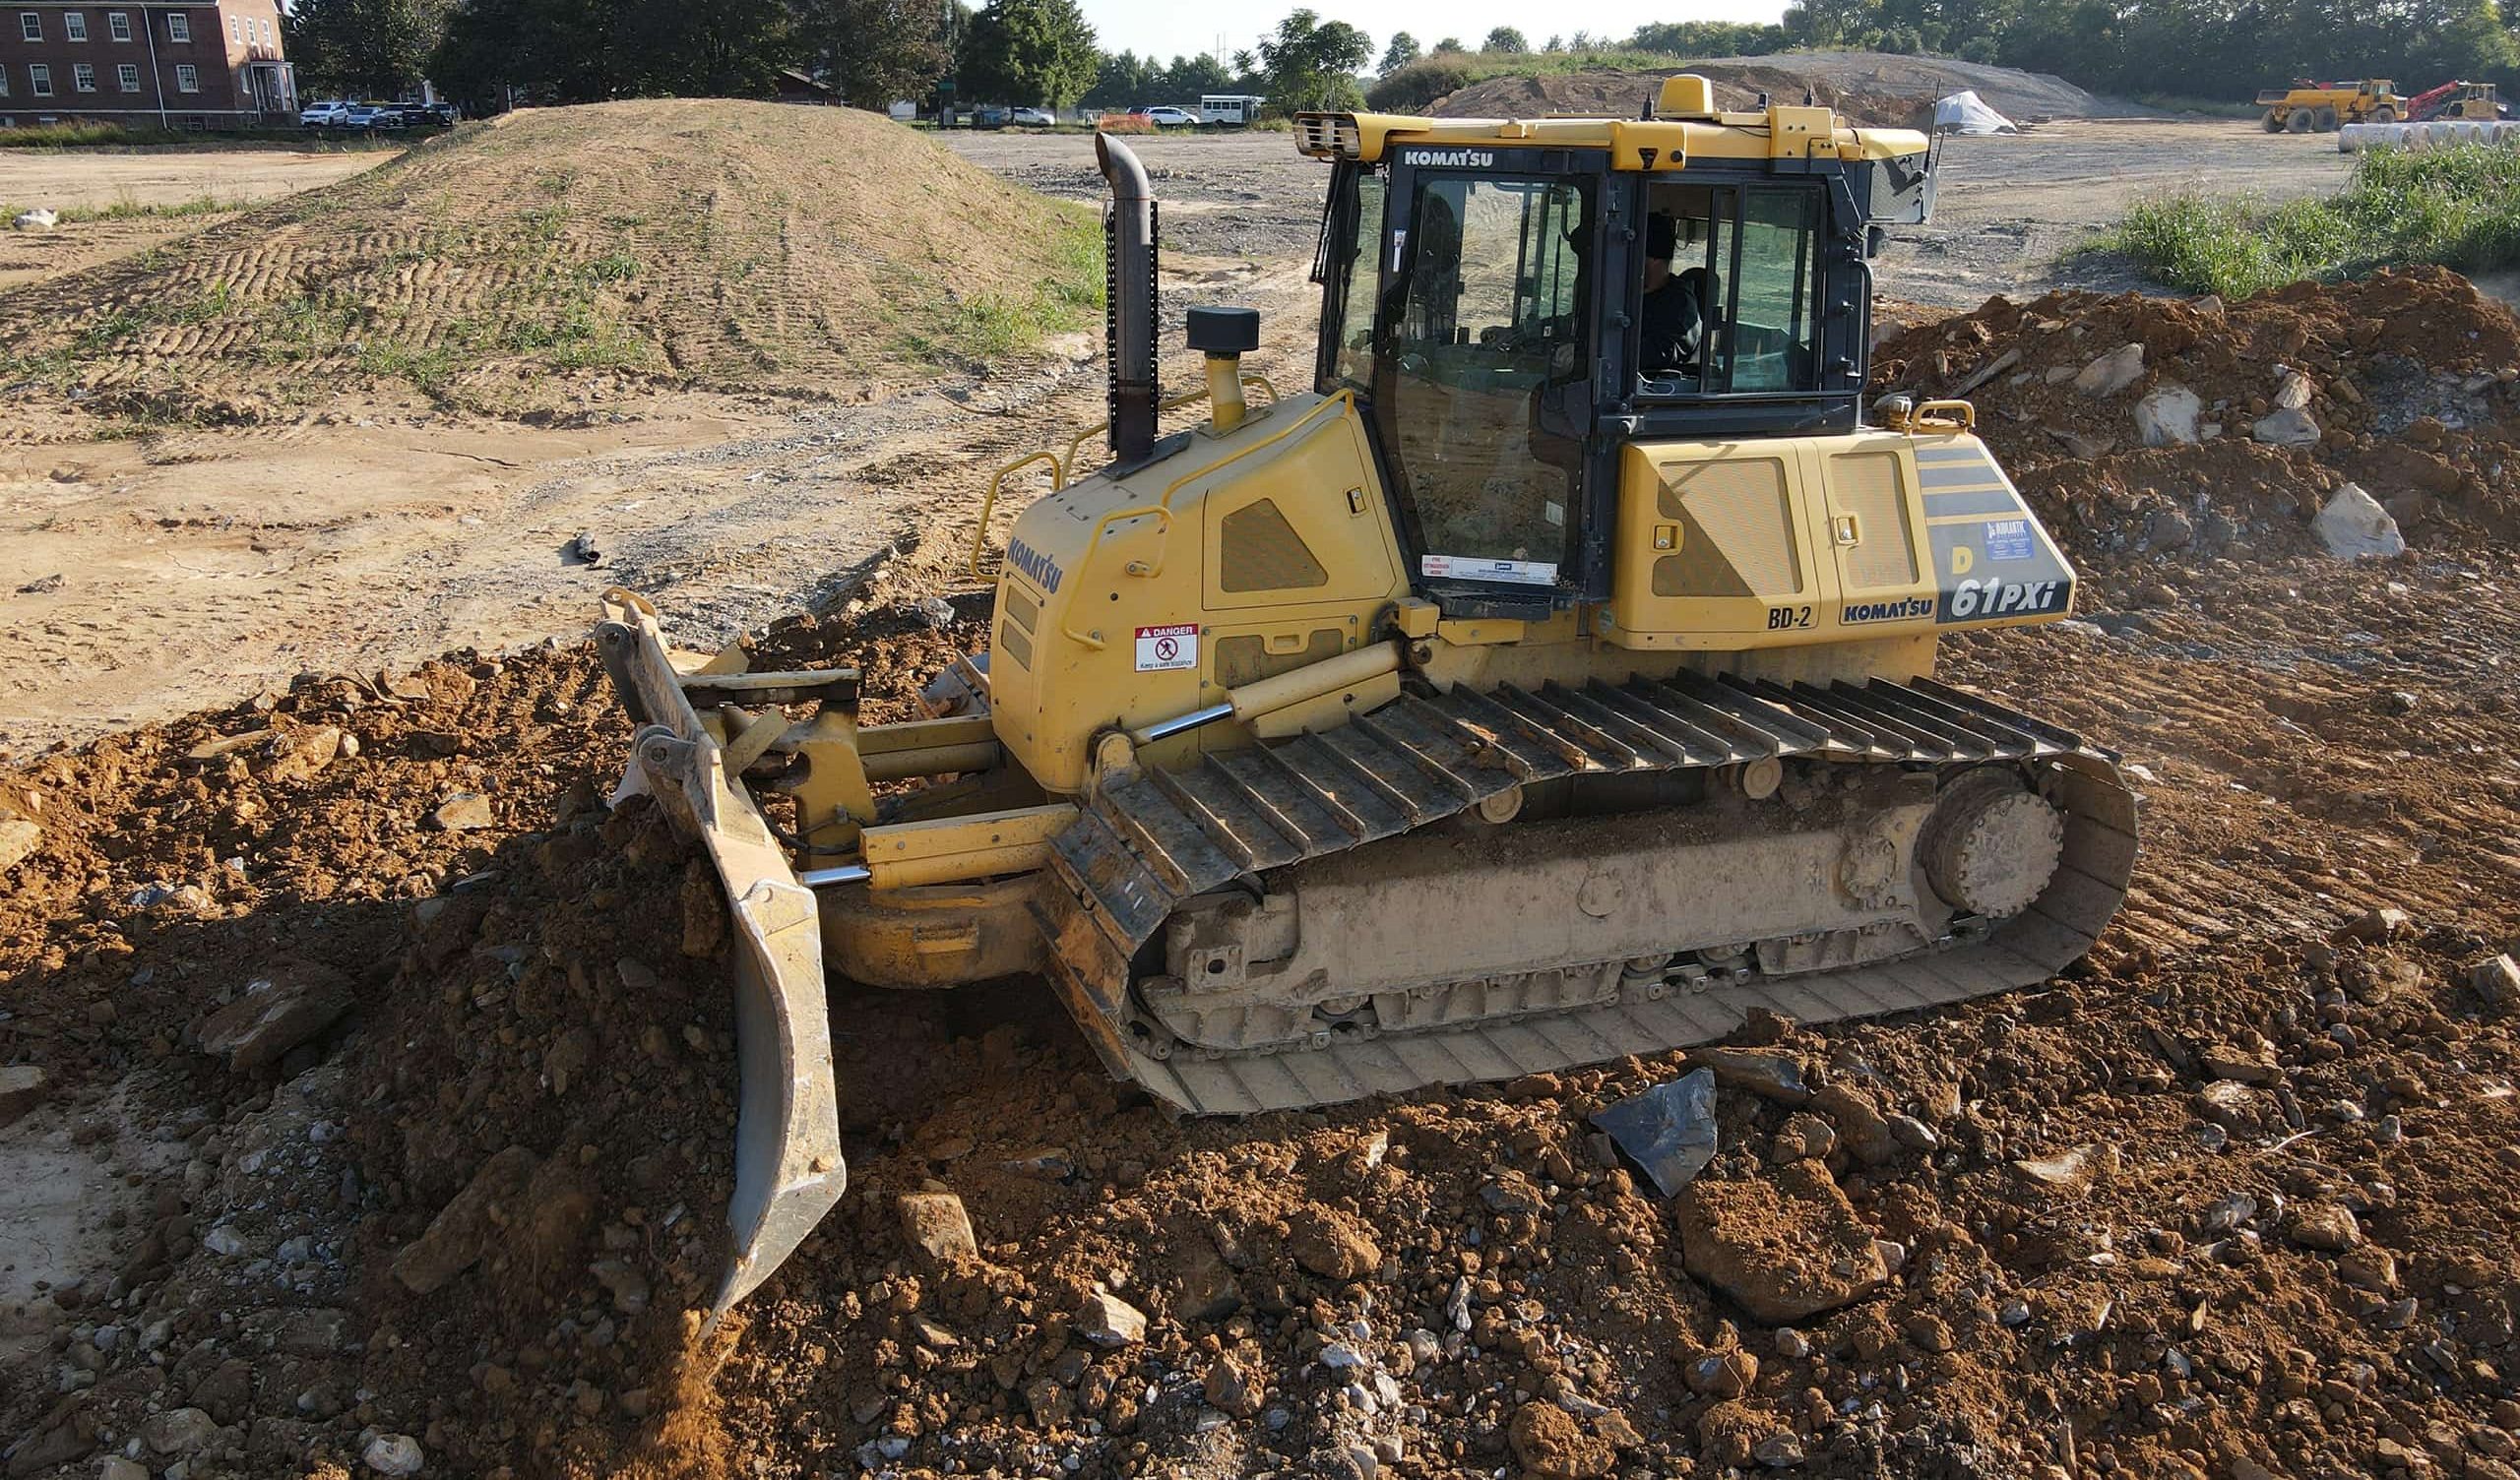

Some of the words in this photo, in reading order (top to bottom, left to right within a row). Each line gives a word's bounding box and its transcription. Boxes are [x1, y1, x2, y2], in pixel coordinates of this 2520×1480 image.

[1405, 149, 1493, 166] KOMATSU
[1007, 536, 1063, 594] KOMATSU
[1952, 546, 1973, 575] D
[1844, 596, 1933, 622] KOMATSU
[1951, 577, 2056, 617] 61PXi
[1768, 606, 1811, 630] BD-2
[1153, 626, 1193, 637] DANGER
